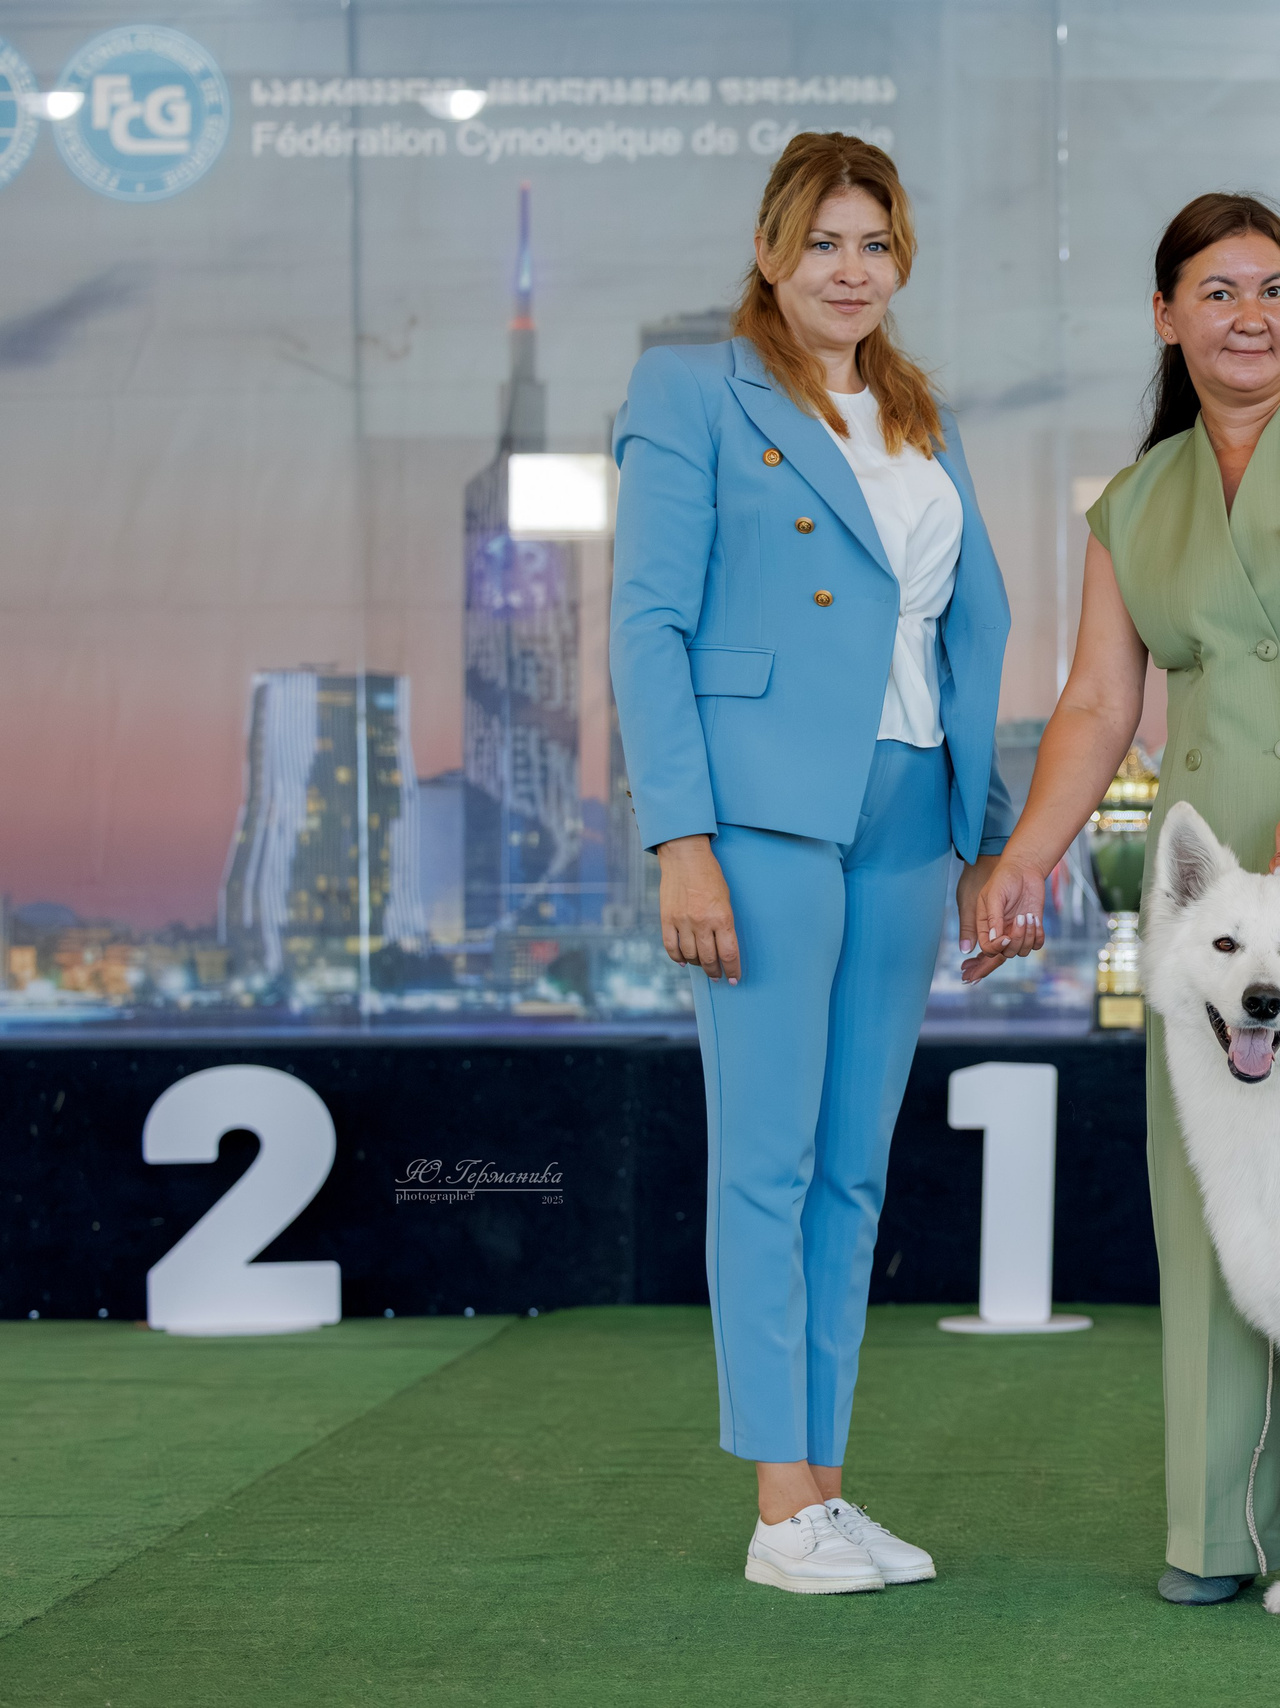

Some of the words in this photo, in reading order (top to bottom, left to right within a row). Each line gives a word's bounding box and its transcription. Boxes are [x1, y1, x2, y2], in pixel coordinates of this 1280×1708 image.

[92, 74, 191, 156] FCG
[252, 121, 446, 157] Fédération
[456, 120, 683, 164] Cynologique
[692, 120, 739, 156] de
[141, 1063, 342, 1332] 2
[947, 1062, 1058, 1328] 1
